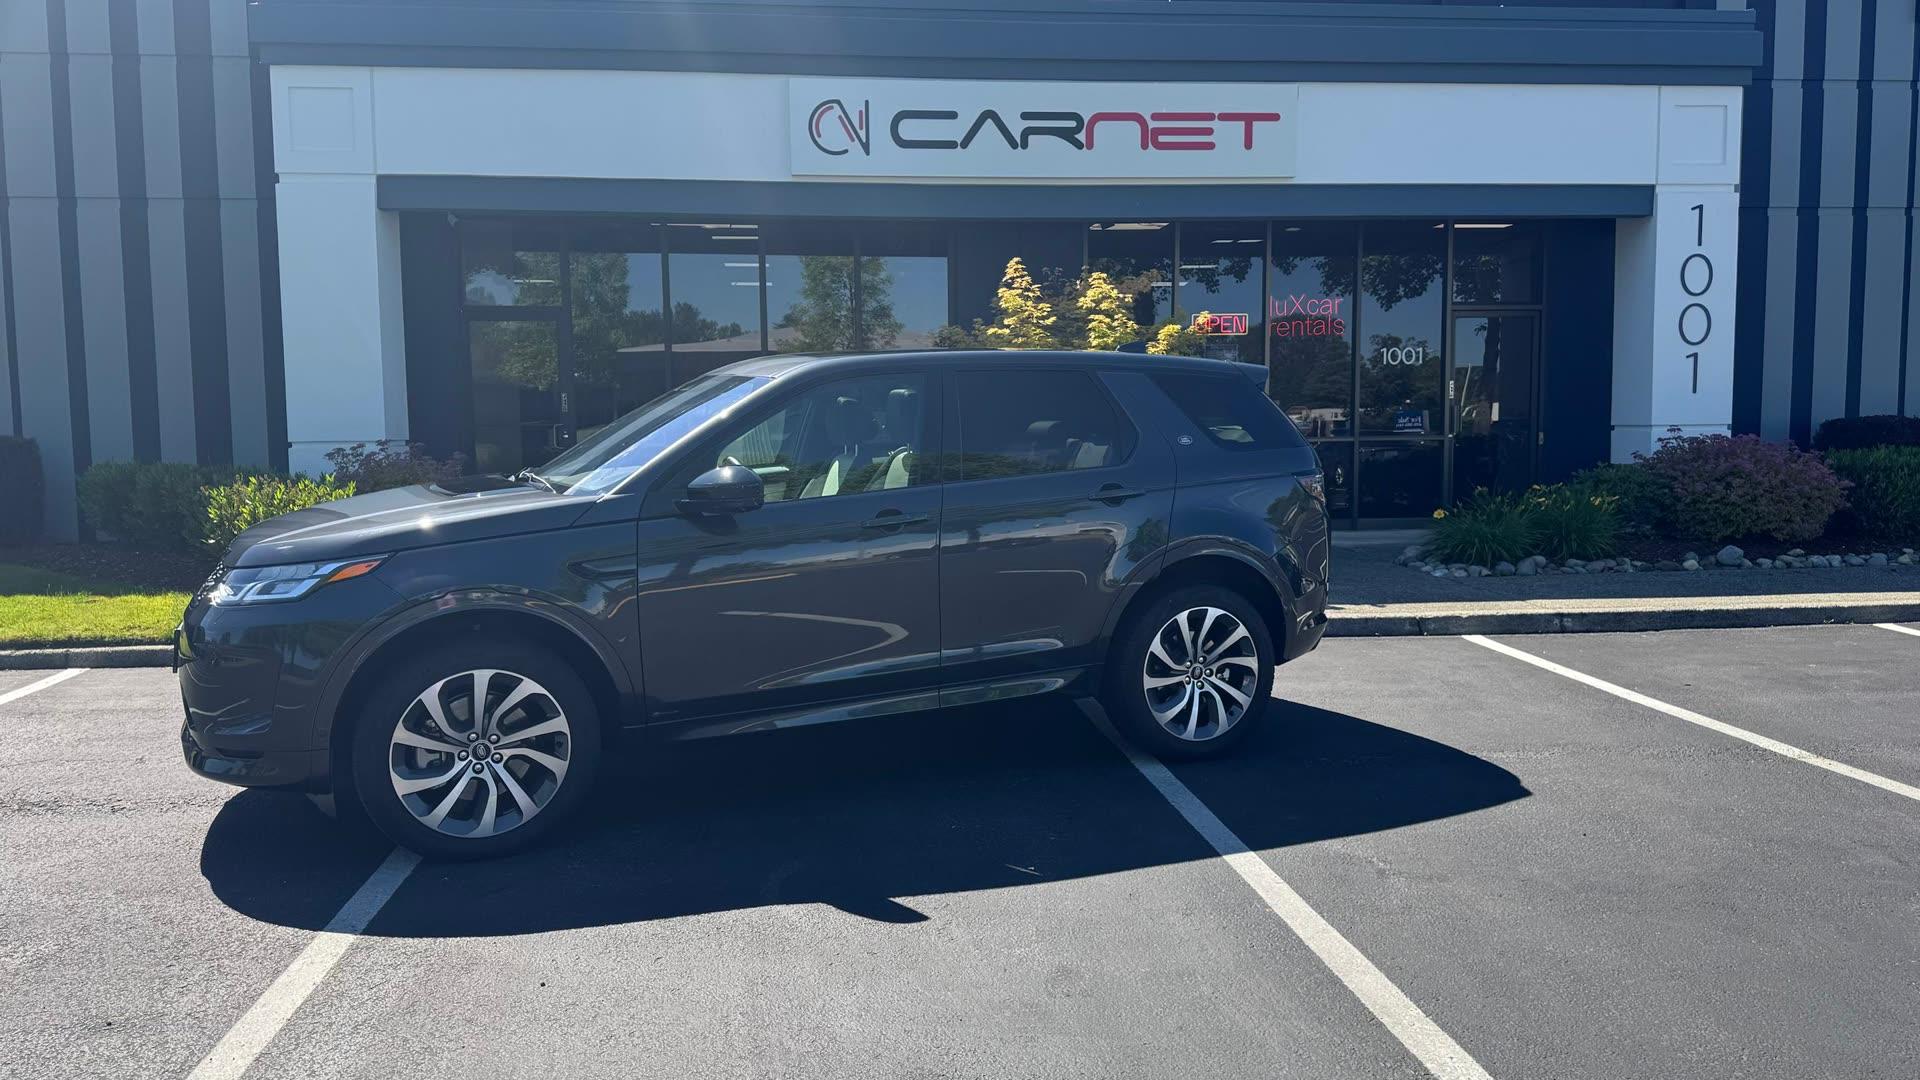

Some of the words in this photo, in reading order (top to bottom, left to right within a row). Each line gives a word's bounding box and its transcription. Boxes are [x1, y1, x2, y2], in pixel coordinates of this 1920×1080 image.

[890, 109, 1281, 151] CARNET
[1678, 204, 1714, 394] 1001
[1195, 315, 1246, 333] OPEN
[1269, 313, 1345, 337] rentals
[1380, 347, 1423, 365] 1001
